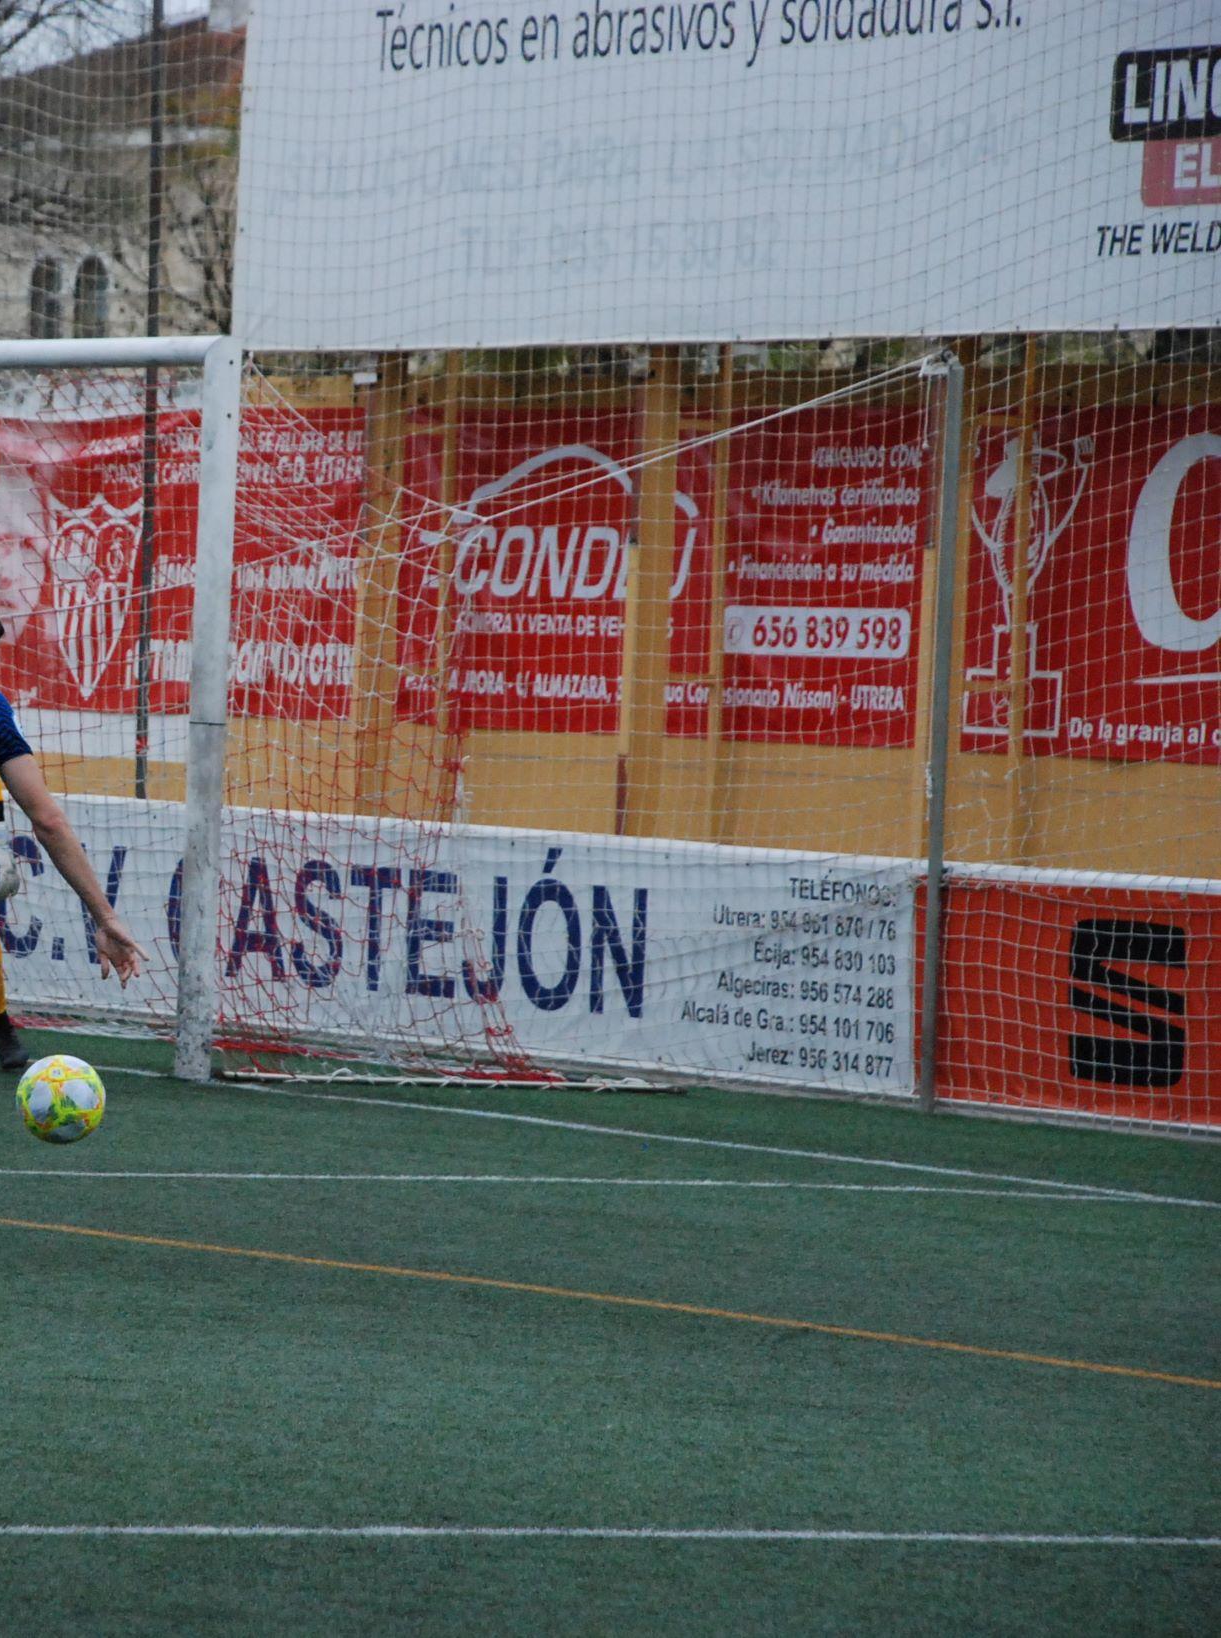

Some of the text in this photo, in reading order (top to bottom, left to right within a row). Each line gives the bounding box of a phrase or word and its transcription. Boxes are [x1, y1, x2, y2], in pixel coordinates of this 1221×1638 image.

[377, 8, 508, 71] Técnicos
[522, 27, 559, 60] en
[573, 0, 735, 58] abrasivos
[748, 10, 764, 67] y
[1097, 224, 1144, 257] THE
[860, 554, 915, 582] medida
[528, 614, 572, 636] VENTA
[576, 616, 597, 637] DE
[752, 616, 902, 650] 656 839 598
[851, 684, 904, 711] UTRERA
[1069, 716, 1093, 739] De
[1099, 717, 1113, 740] la
[1116, 722, 1184, 748] granja
[1187, 722, 1207, 744] al
[168, 846, 648, 1018] ASTEJÓN
[713, 904, 766, 928] Utrera:
[835, 916, 863, 938] 870
[879, 919, 896, 941] 76
[754, 937, 896, 976] Écija: 954 830 103
[717, 971, 795, 998] Algeciras:
[800, 979, 828, 1002] 956
[834, 982, 862, 1006] 574
[681, 1000, 729, 1026] Alcalá
[734, 1005, 752, 1027] de
[800, 1013, 827, 1036] 954
[834, 1016, 859, 1040] 101
[867, 1020, 894, 1044] 706
[748, 1041, 794, 1066] Jerez:
[832, 1050, 859, 1073] 314
[865, 1054, 894, 1078] 877
